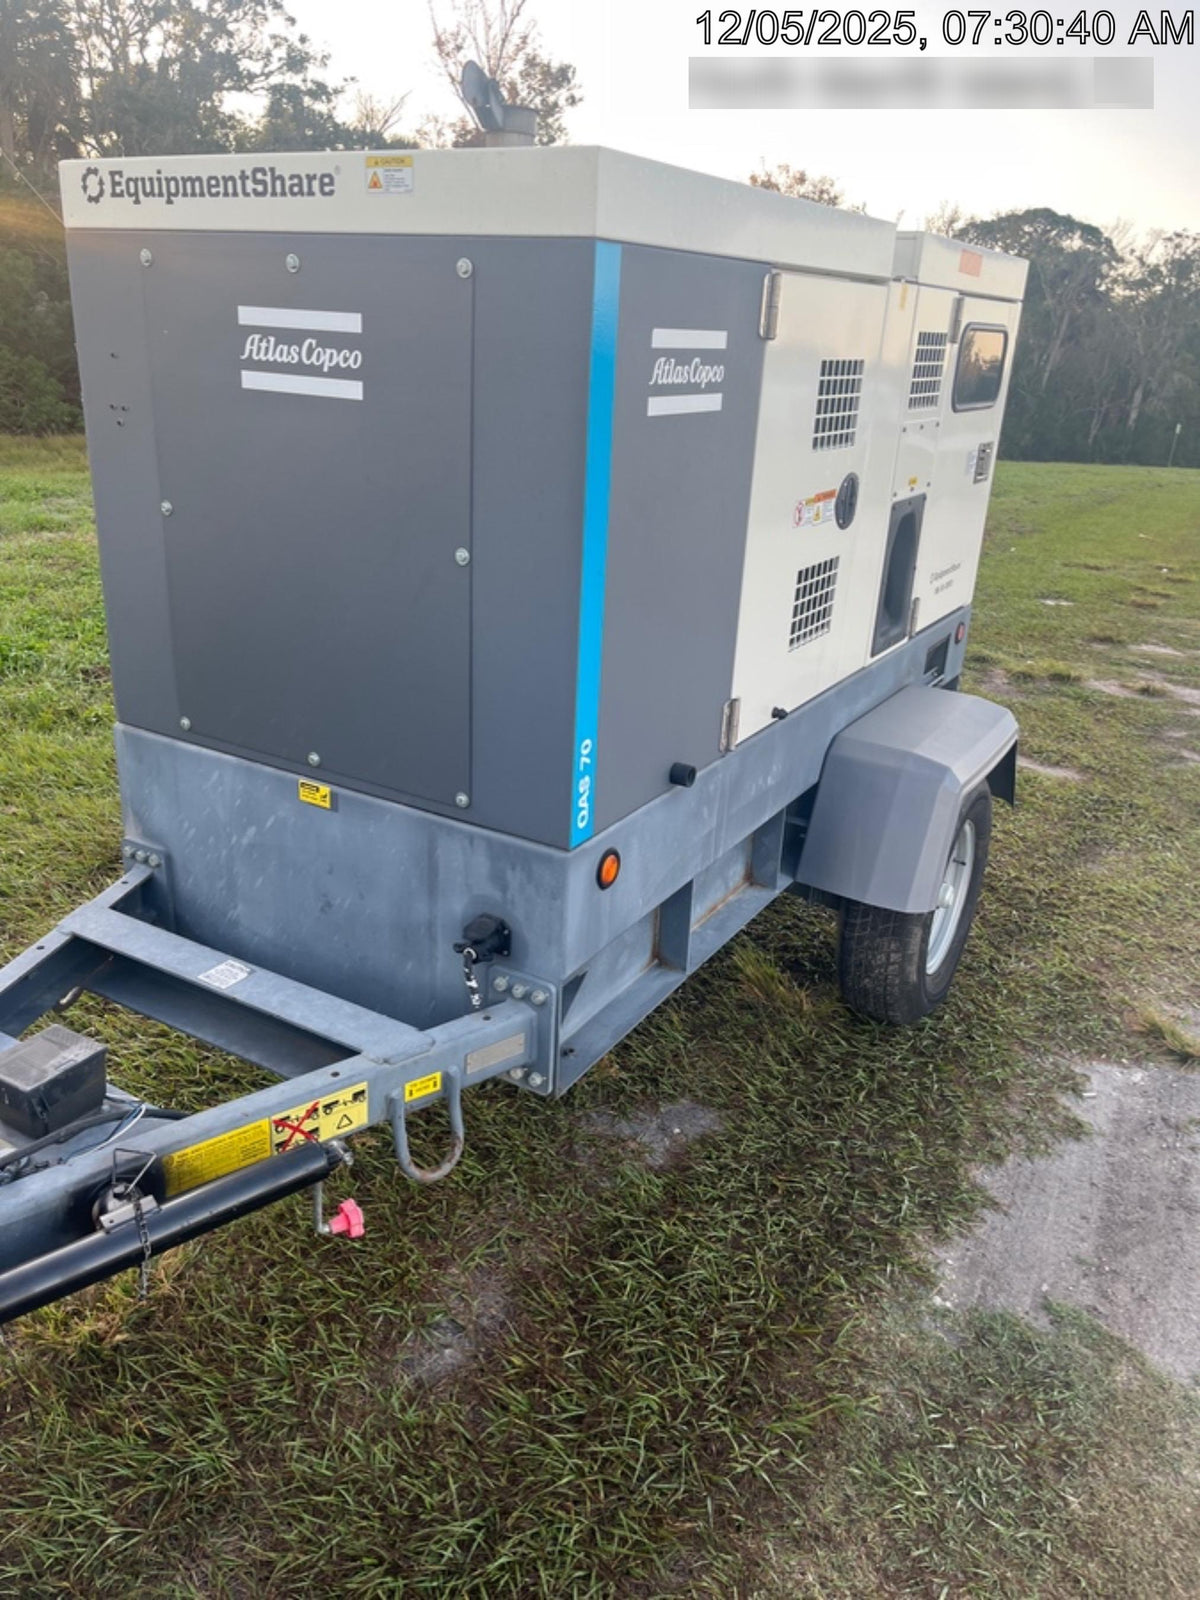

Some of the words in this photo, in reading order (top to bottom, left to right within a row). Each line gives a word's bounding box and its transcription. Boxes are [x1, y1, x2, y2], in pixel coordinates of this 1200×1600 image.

[109, 166, 336, 205] EquipmentShare
[240, 333, 300, 364] Atlas
[301, 337, 362, 373] Copco
[648, 356, 690, 385] Atlas
[690, 356, 725, 389] Copco
[579, 738, 593, 772] 70
[577, 775, 591, 829] QAS
